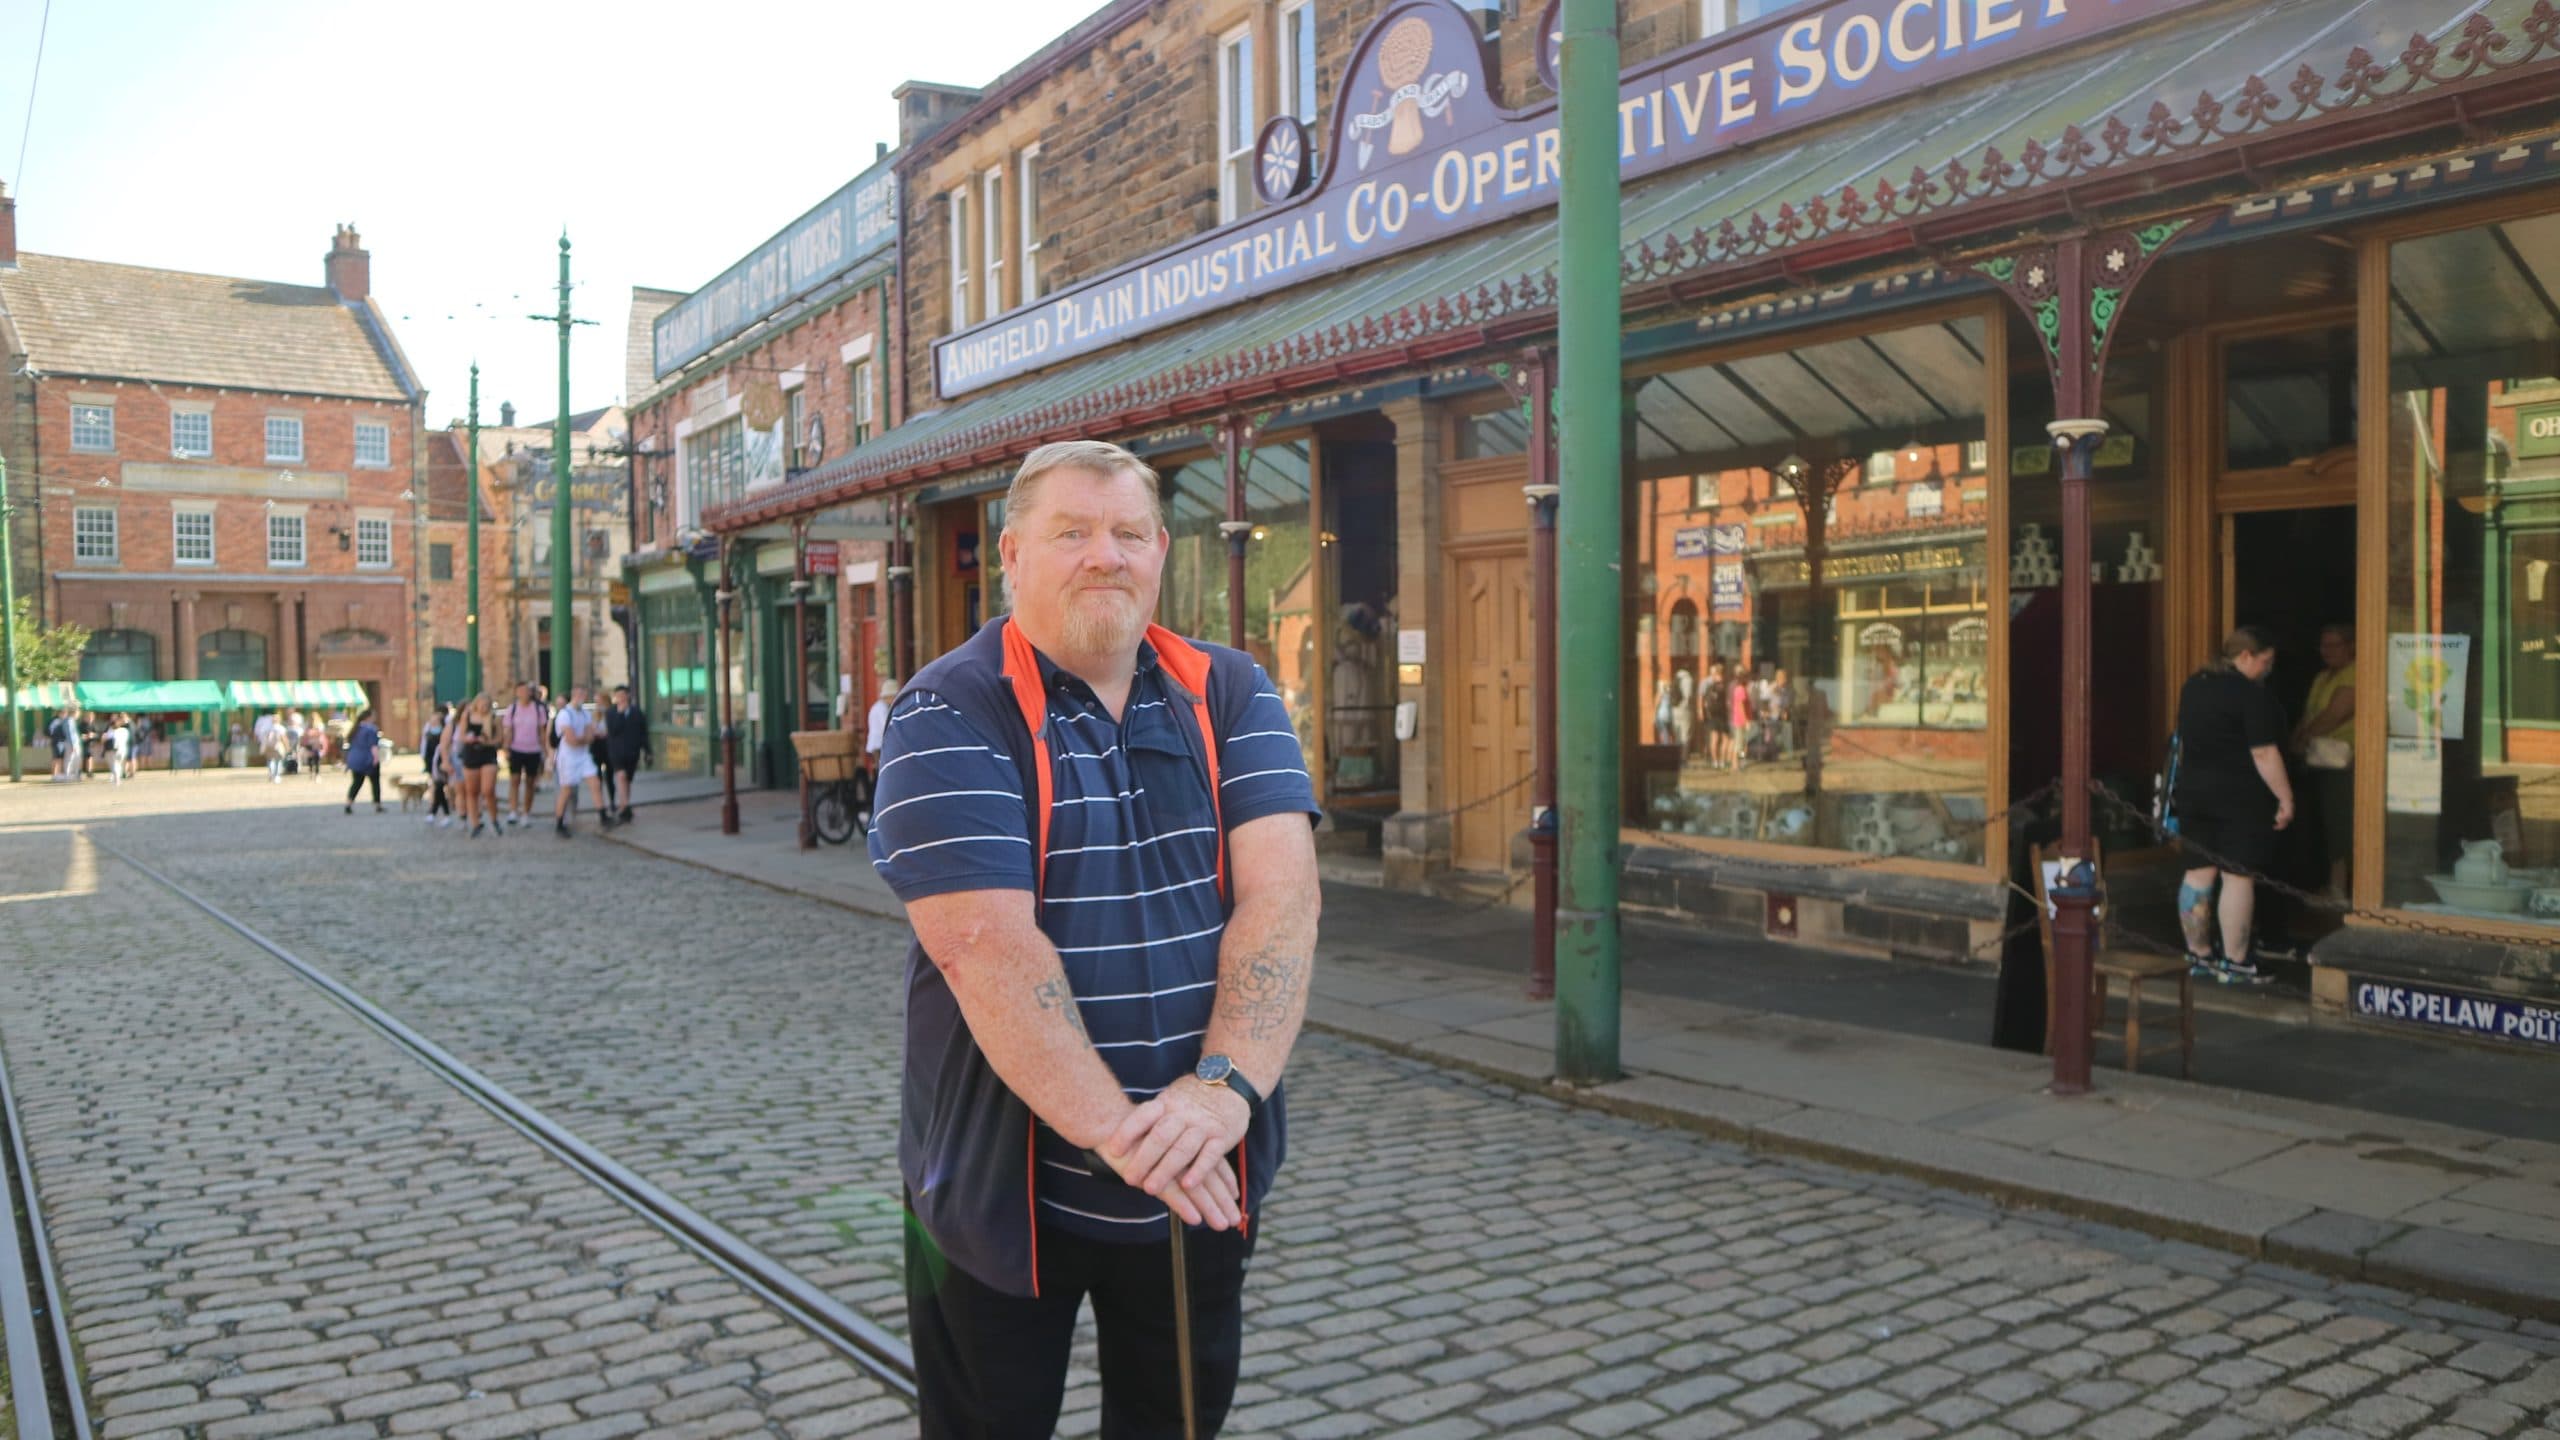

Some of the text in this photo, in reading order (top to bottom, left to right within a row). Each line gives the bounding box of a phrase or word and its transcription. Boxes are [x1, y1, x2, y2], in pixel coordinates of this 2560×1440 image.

[789, 207, 842, 281] WORKS
[945, 318, 1050, 384] ANNFIELD
[1056, 284, 1134, 345] PLAIN
[1140, 210, 1337, 318] INDUSTRIAL
[2411, 992, 2497, 1030] PELAW
[2503, 1012, 2560, 1042] POLI
